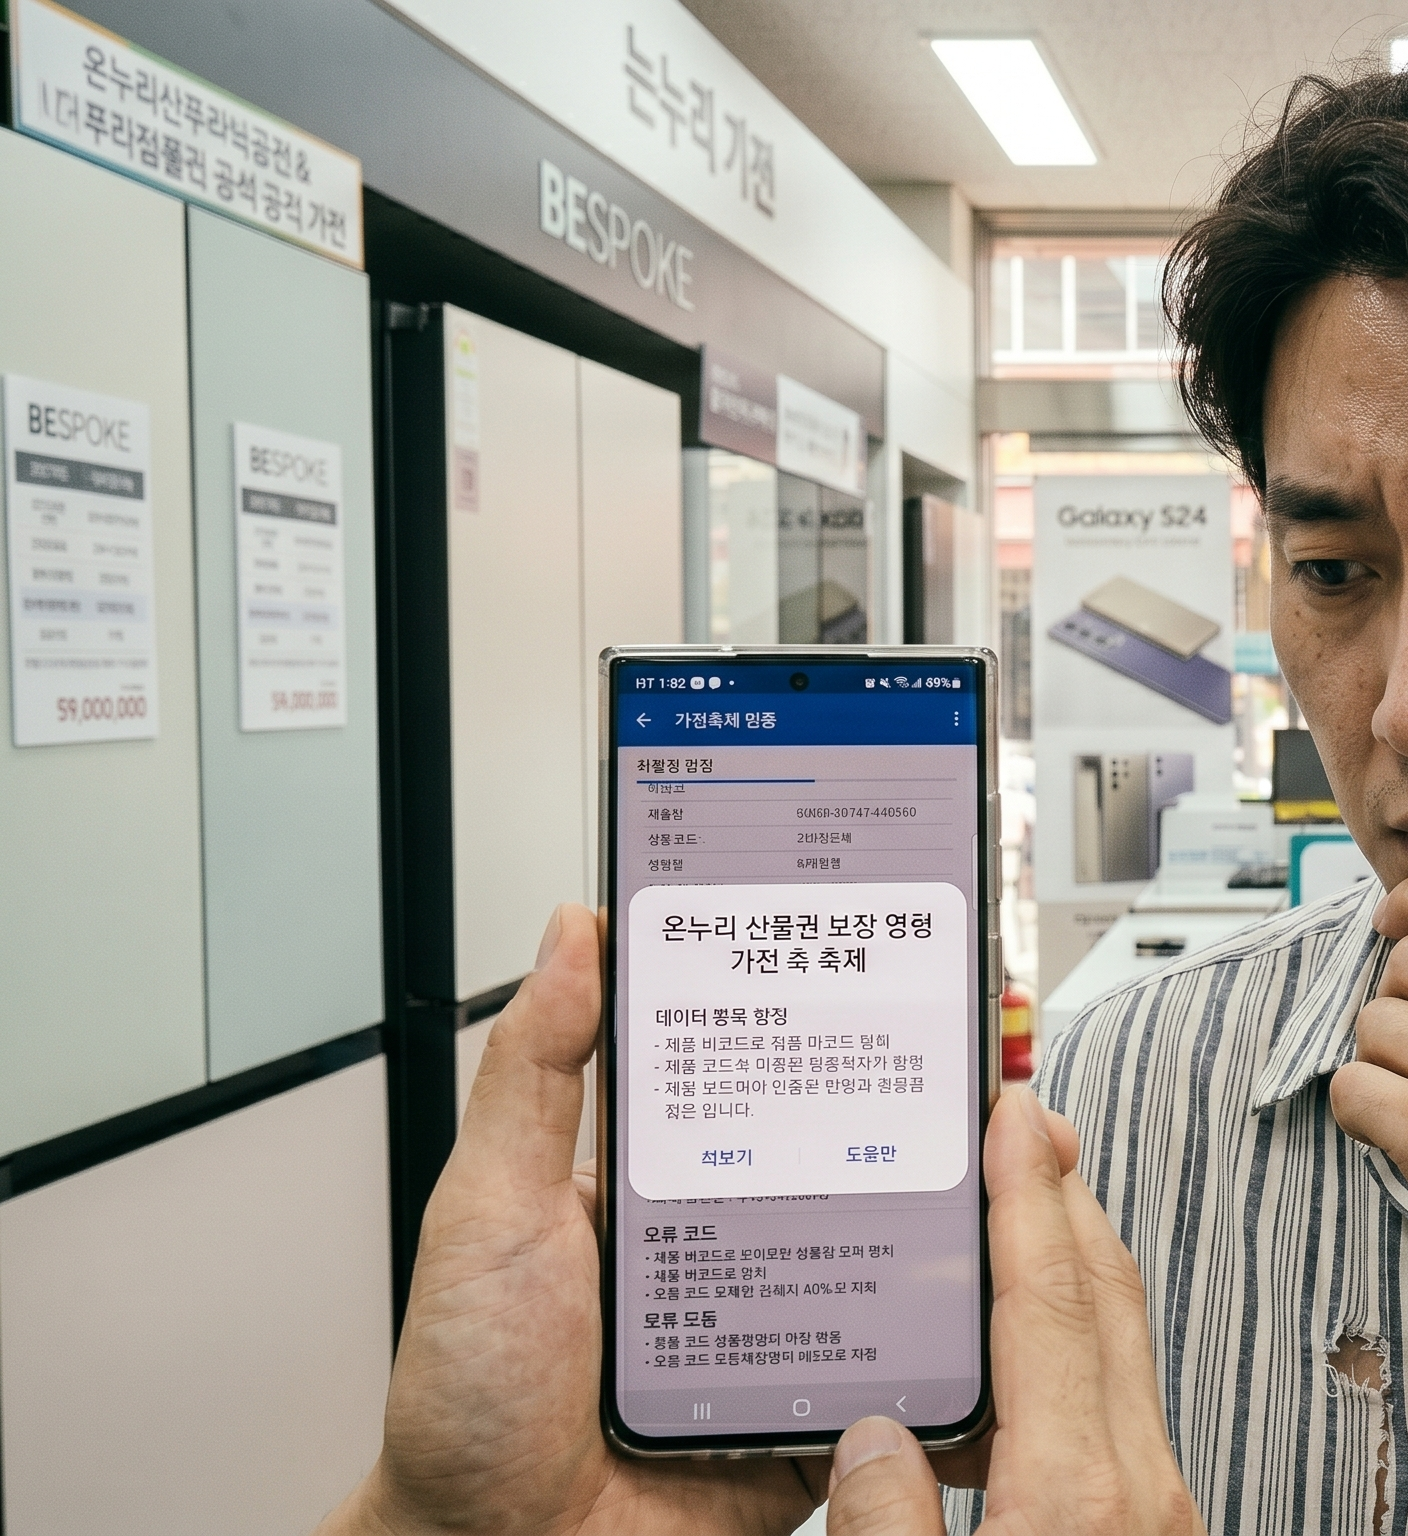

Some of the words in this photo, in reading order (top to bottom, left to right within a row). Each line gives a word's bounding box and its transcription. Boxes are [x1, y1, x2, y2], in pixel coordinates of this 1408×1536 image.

[540, 158, 694, 312] BESPOKE
[28, 402, 131, 452] BESPOKE
[250, 445, 328, 487] BESPOKE
[1057, 505, 1154, 533] Galaxy
[1161, 504, 1208, 527] S24
[662, 915, 735, 941] 온누리
[746, 914, 818, 940] 산물권
[828, 913, 877, 939] 보장
[731, 948, 778, 974] 가전
[787, 948, 809, 973] 축
[818, 947, 865, 973] 축제
[656, 1008, 706, 1027] 데이터
[702, 1102, 754, 1119] 입니다.
[644, 1226, 678, 1243] 오류
[683, 1225, 717, 1241] 코드
[684, 1287, 710, 1299] 코드
[685, 1336, 709, 1348] 코드
[684, 1354, 710, 1366] 코드
